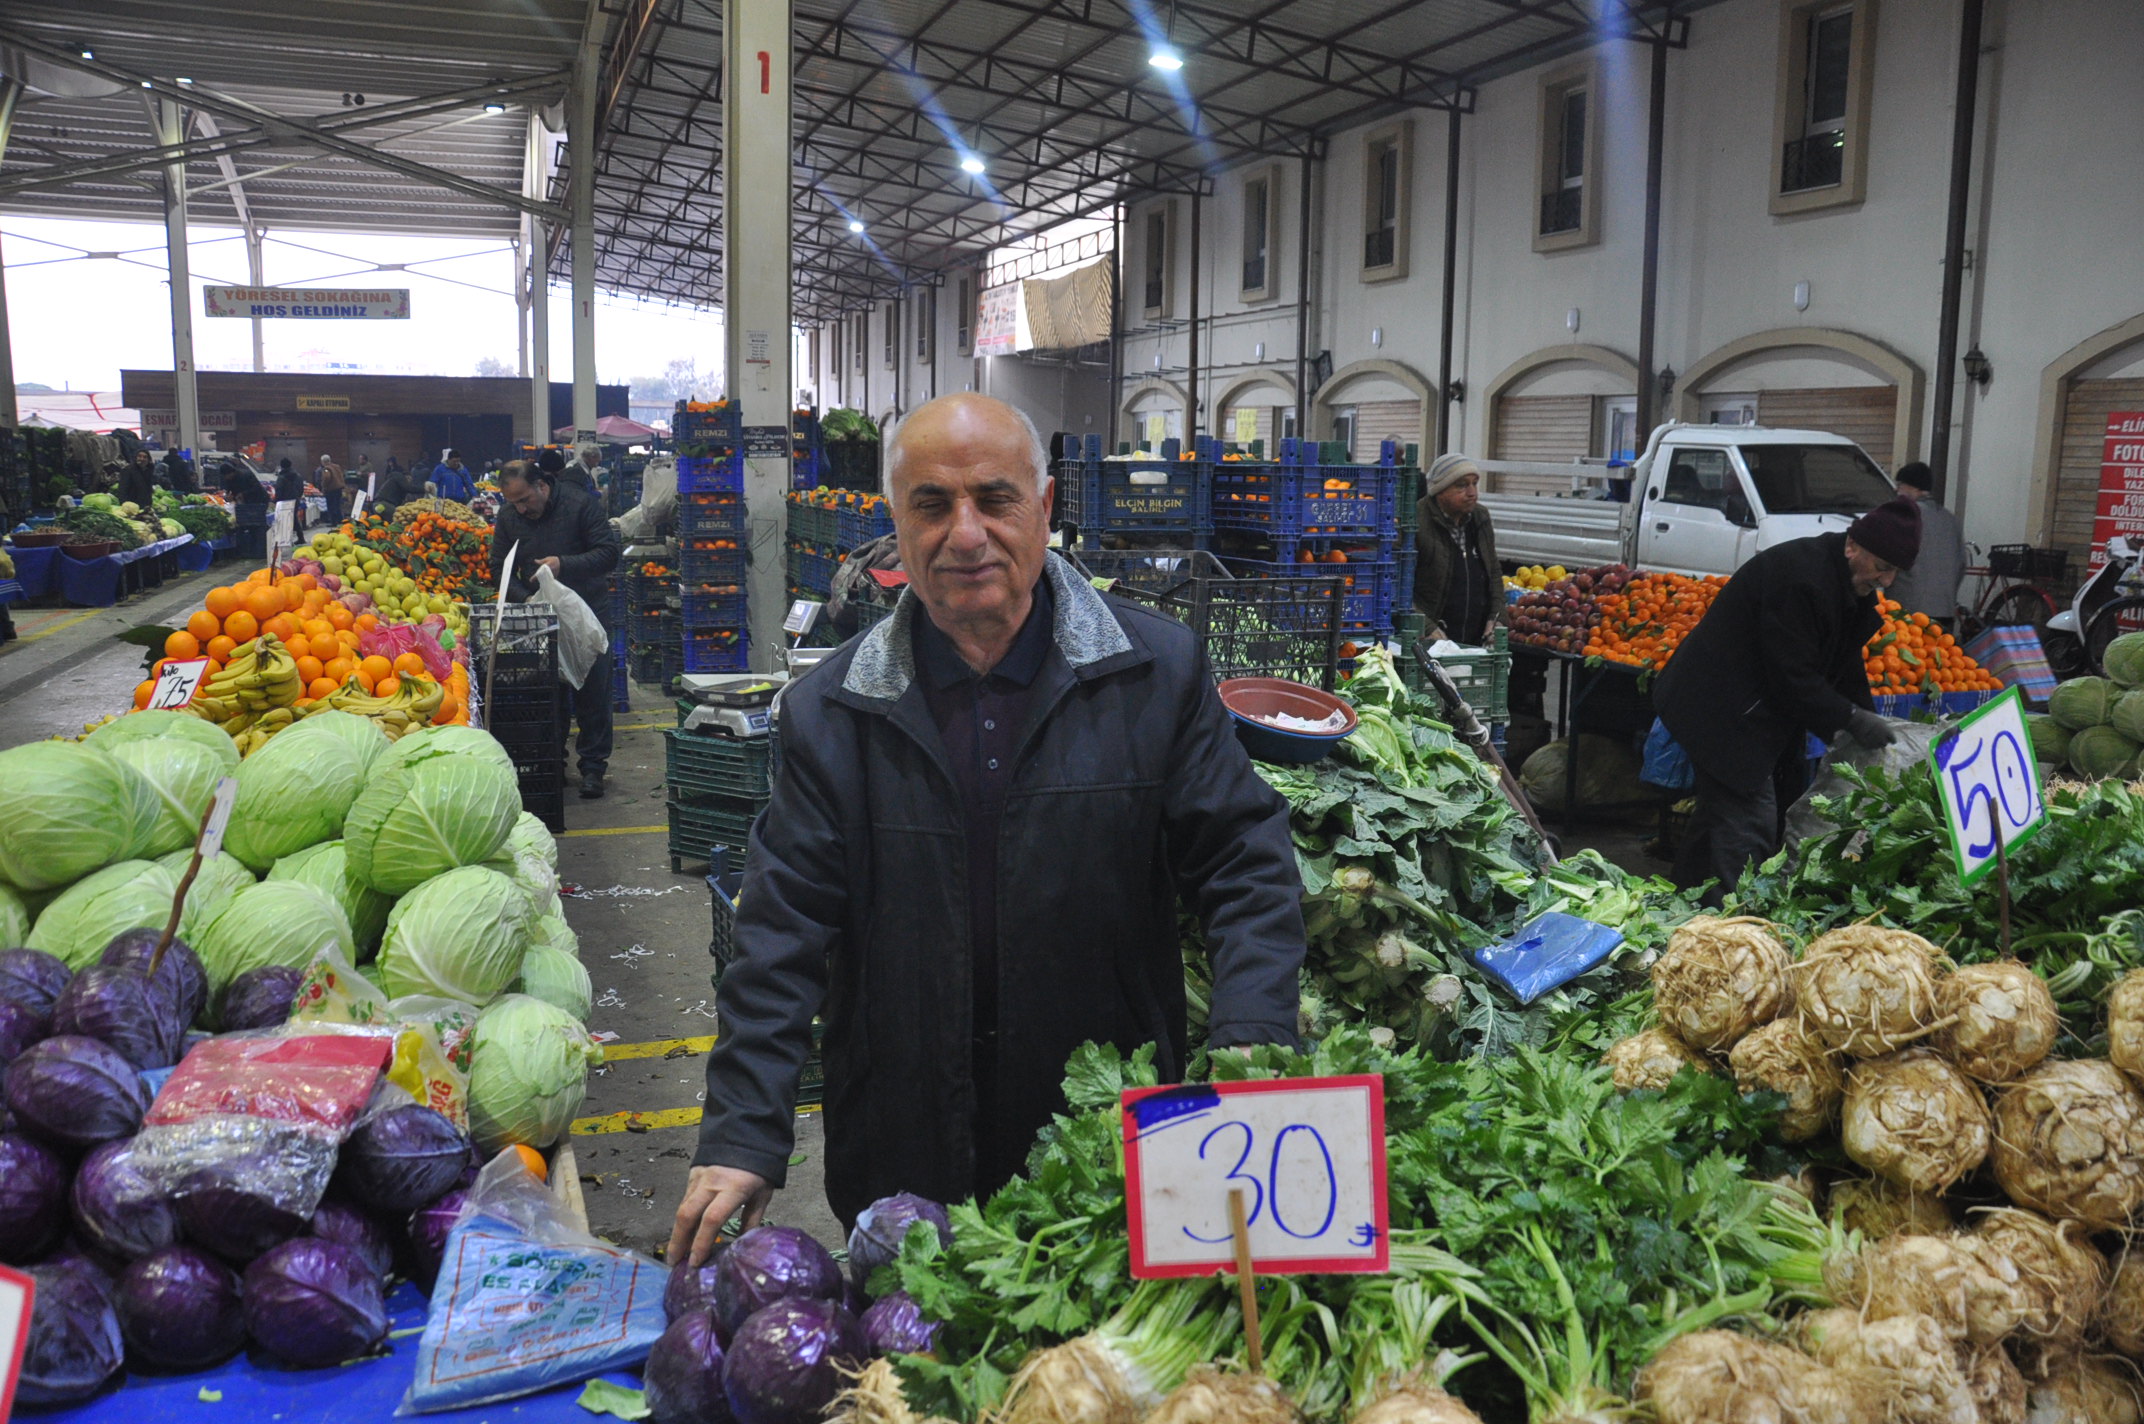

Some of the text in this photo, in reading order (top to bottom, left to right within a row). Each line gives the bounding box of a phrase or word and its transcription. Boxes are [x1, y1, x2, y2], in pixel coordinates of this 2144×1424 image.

[757, 51, 770, 95] 1
[223, 289, 392, 303] YÖRESEL SOKAĞINA
[251, 304, 368, 318] HOŞ GELDİNİZ
[582, 301, 588, 318] 1
[180, 360, 188, 372] 2
[162, 676, 194, 708] 75
[1950, 730, 2032, 858] 50
[1183, 1121, 1336, 1243] 30
